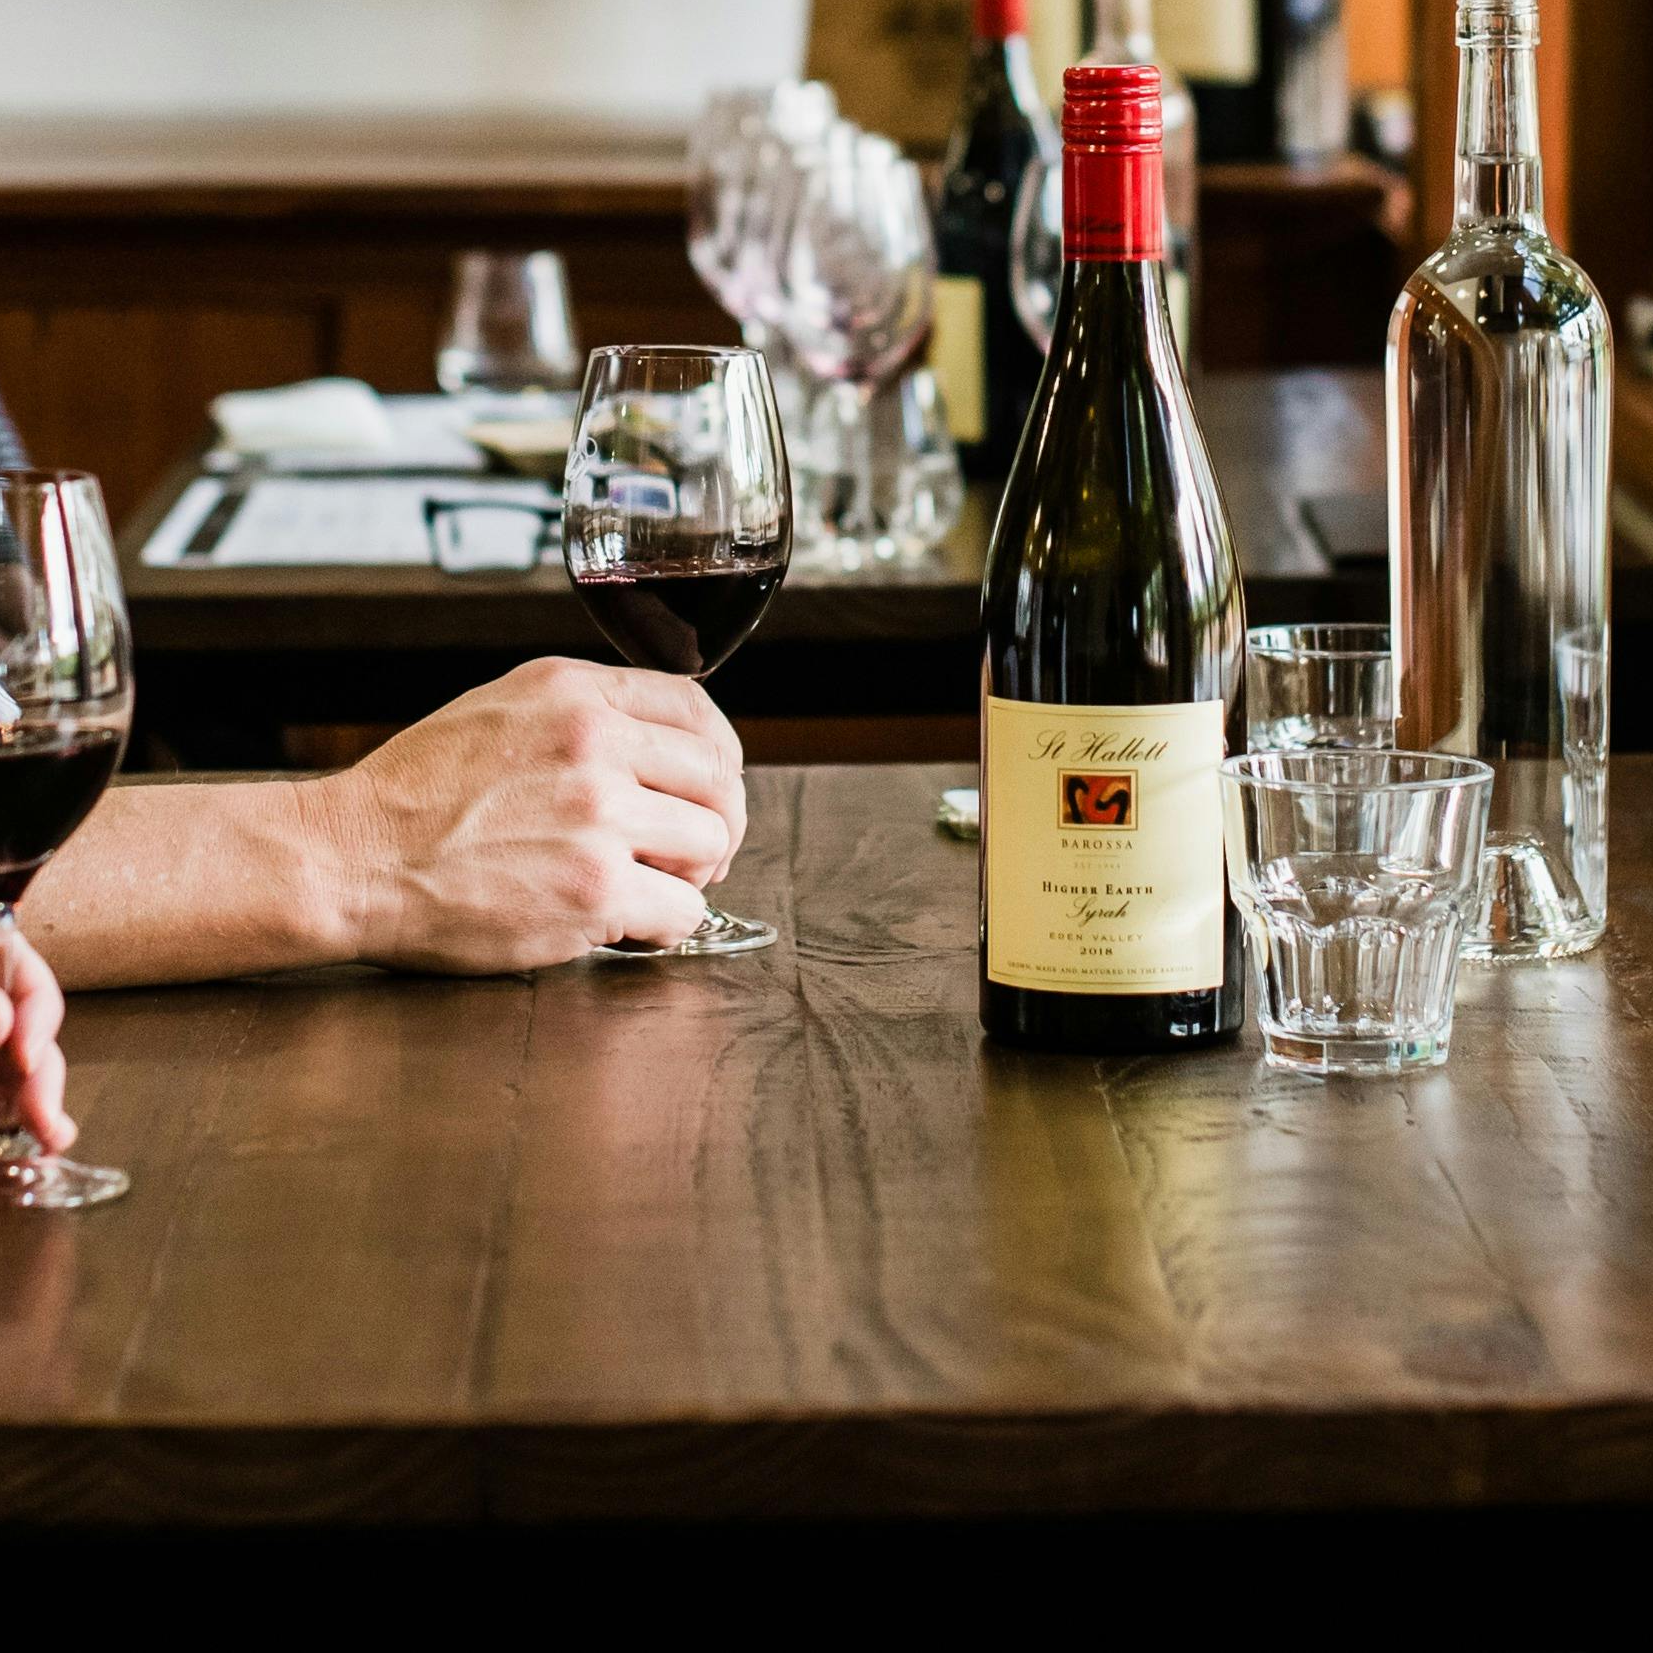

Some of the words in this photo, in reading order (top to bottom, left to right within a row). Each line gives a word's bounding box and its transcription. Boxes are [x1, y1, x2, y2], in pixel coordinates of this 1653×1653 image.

[1028, 729, 1066, 760] St
[1070, 731, 1169, 762] Hallett
[1061, 838, 1133, 850] BAROSSA
[1042, 881, 1097, 894] HIGHER
[1106, 883, 1153, 895] EARTH
[1066, 896, 1130, 927] Syrah
[1049, 932, 1083, 941] EDEN
[1092, 933, 1143, 942] VALLEY
[1080, 947, 1114, 955] 2018
[1081, 967, 1124, 975] MATURED
[1141, 967, 1156, 975] THE
